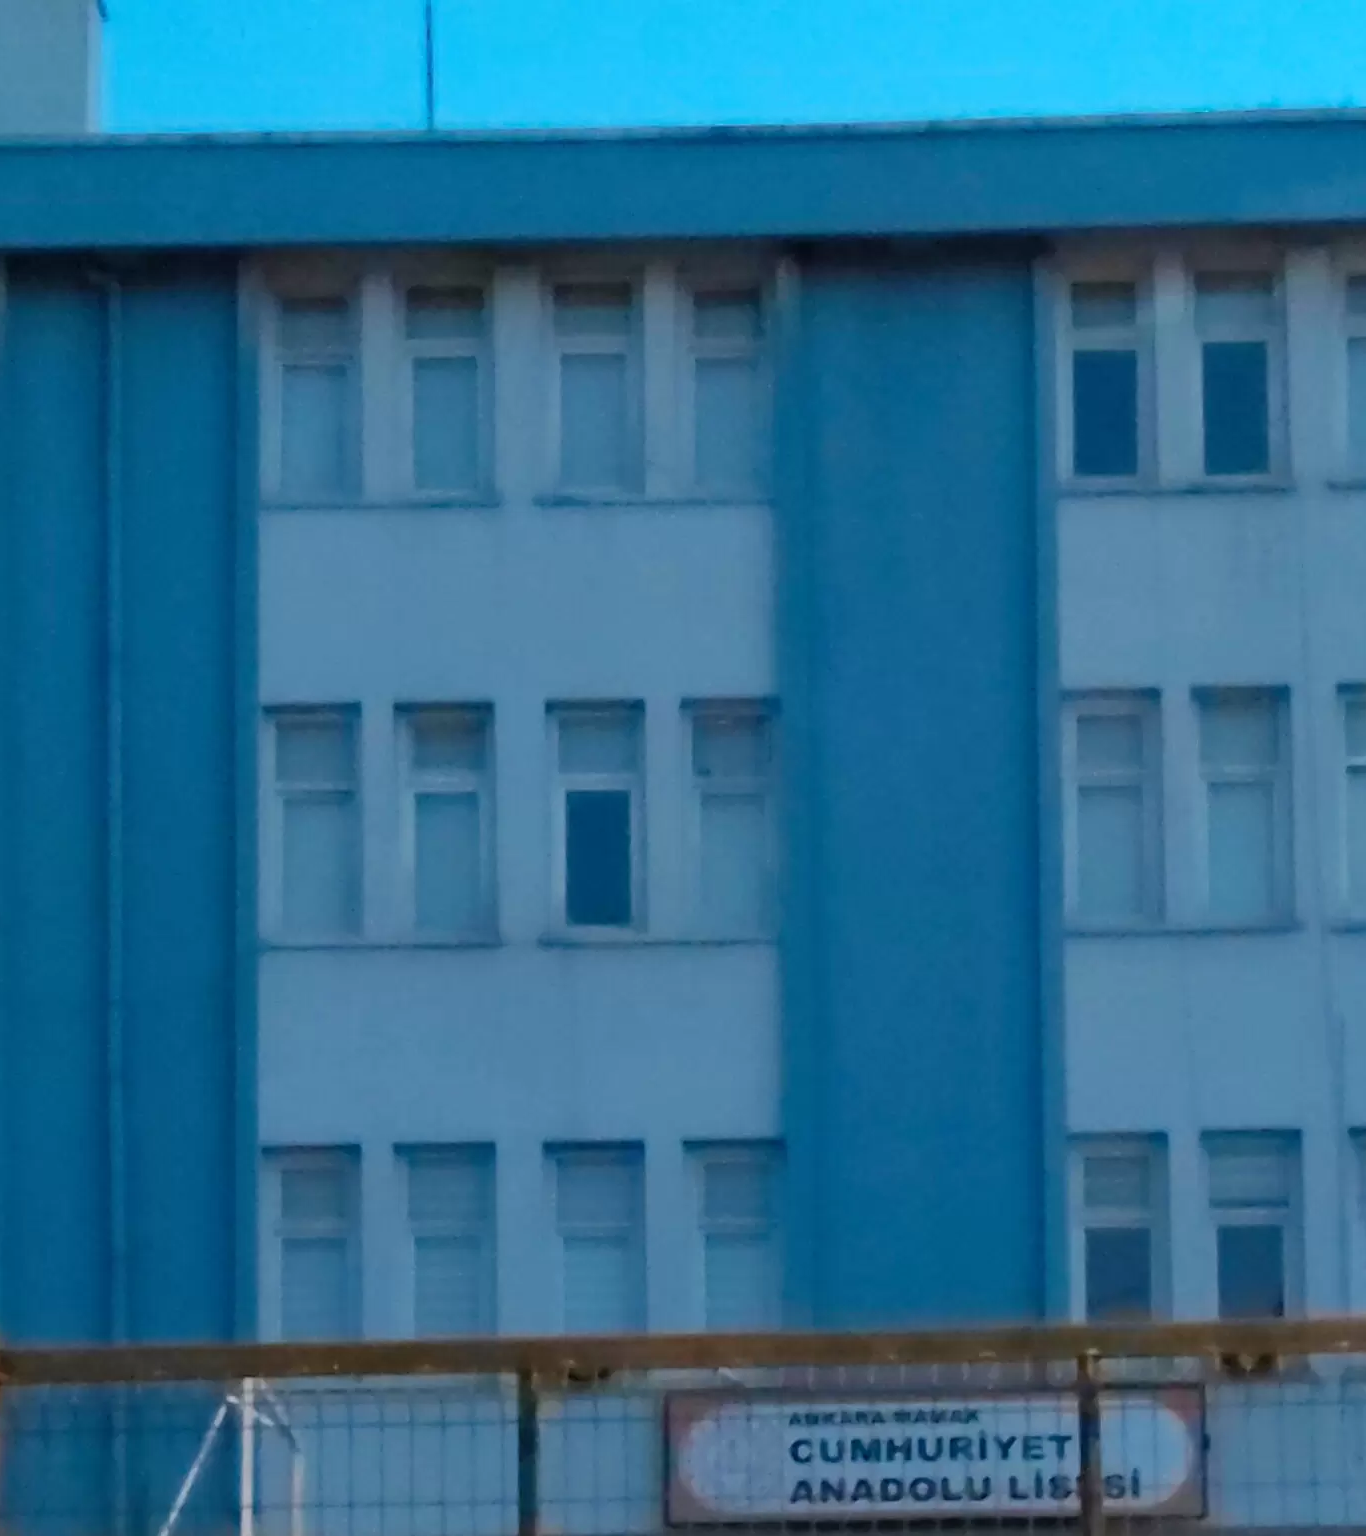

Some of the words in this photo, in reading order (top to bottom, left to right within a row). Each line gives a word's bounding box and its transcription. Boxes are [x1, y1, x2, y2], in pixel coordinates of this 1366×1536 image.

[789, 1430, 1073, 1465] CUMHURİYET
[790, 1475, 992, 1505] ANADOLU
[1008, 1468, 1141, 1501] LİSSİ
